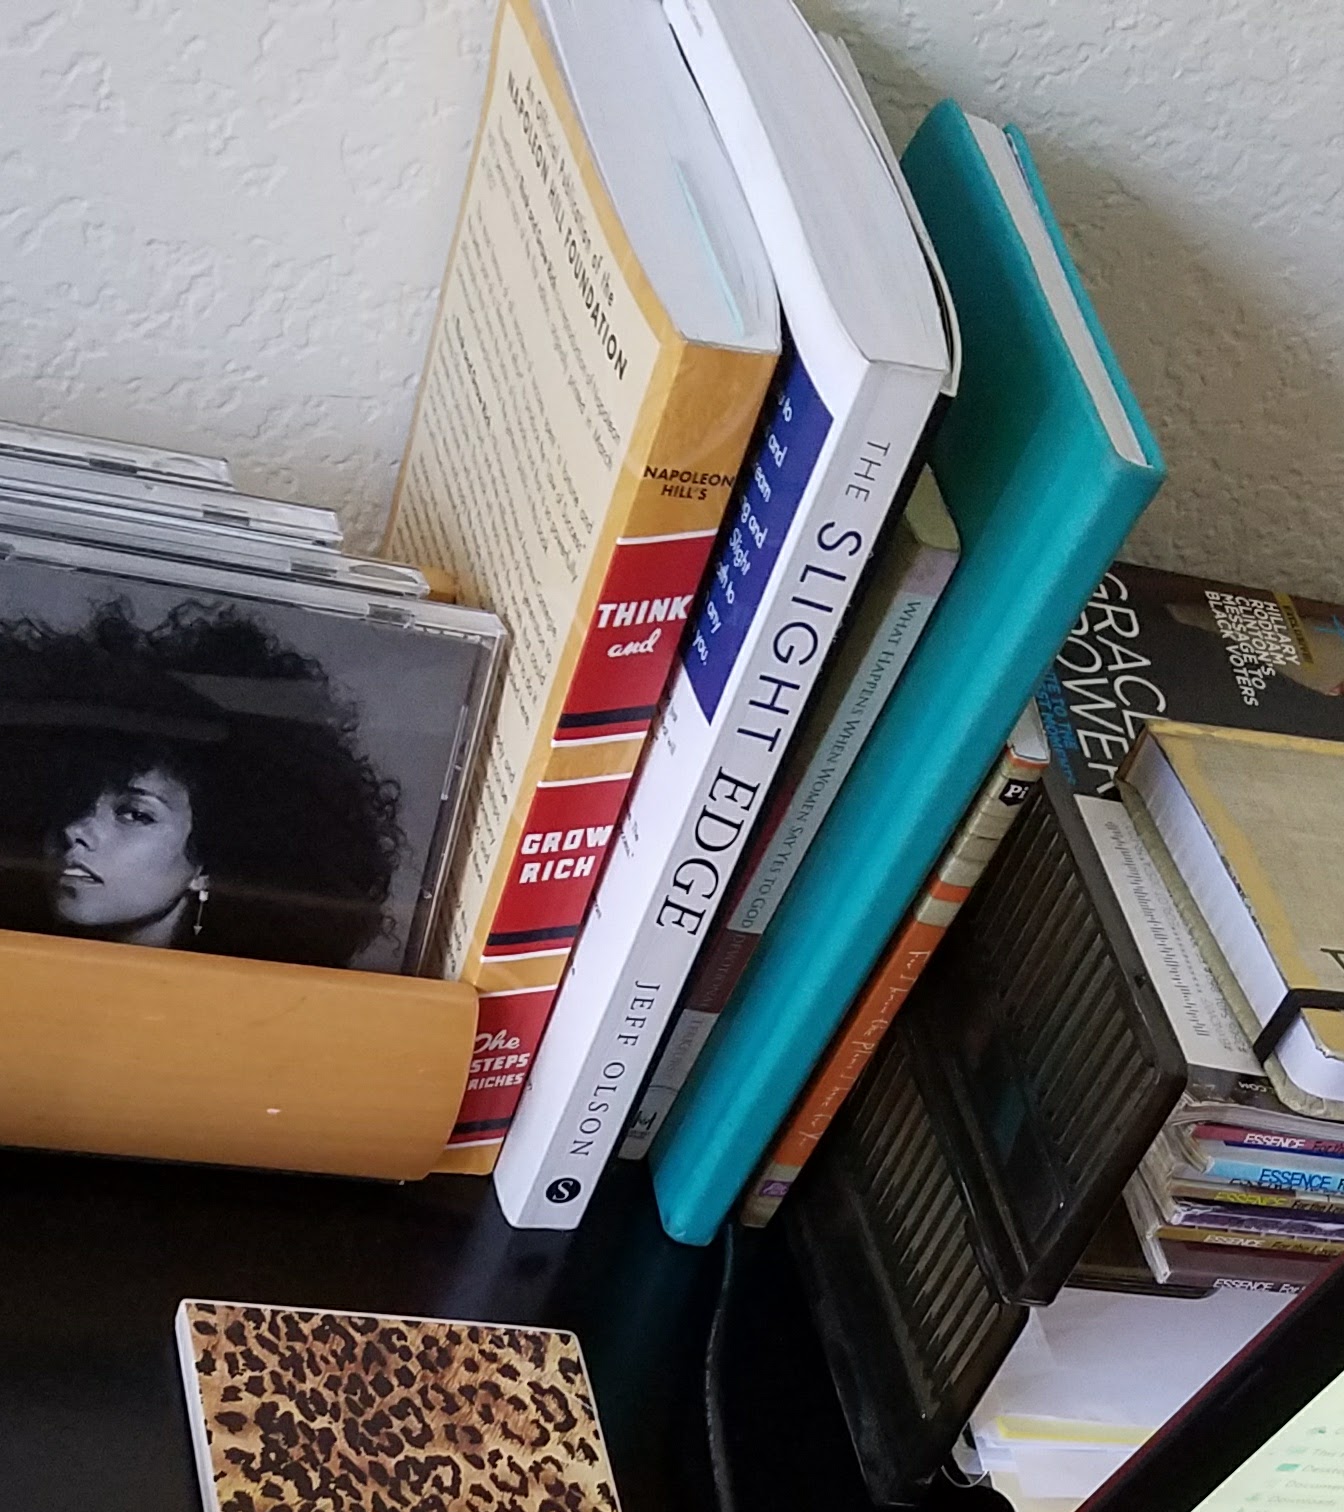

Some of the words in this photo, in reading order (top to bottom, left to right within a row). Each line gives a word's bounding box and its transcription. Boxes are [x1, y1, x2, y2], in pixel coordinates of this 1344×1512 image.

[507, 69, 549, 184] NAPOLEON
[548, 179, 566, 234] HILL
[564, 227, 628, 380] FOUNDATION
[644, 465, 738, 488] NAPOLEON
[844, 440, 891, 503] THE
[597, 594, 695, 629] THINK
[885, 600, 921, 645] WHAT
[1219, 592, 1259, 667] MESSAGE
[1248, 597, 1287, 667] RODHAM
[1262, 600, 1301, 666] HILLARY
[607, 628, 662, 658] and
[737, 521, 863, 752] SLIGHT
[1204, 589, 1236, 640] BLACK
[1225, 644, 1260, 707] VOTERS
[1234, 595, 1276, 678] CLINTON'S
[849, 650, 896, 715] HAPPENS
[825, 719, 860, 763] WHEN
[794, 765, 835, 822] WOMEN
[520, 825, 614, 856] GROW
[656, 766, 761, 937] EDGE
[780, 825, 804, 848] SAY
[518, 855, 596, 884] RICH
[739, 897, 767, 929] GOD
[617, 980, 662, 1048] JEFF
[467, 1072, 525, 1091] RICHES
[469, 1053, 530, 1073] STEPS
[570, 1060, 626, 1157] OLSON
[1244, 1133, 1306, 1149] ESSENCE
[1259, 1168, 1332, 1189] ESSENCE
[1204, 1235, 1266, 1248] ESSENCE
[1213, 1278, 1274, 1291] ESSENCE
[1279, 1284, 1300, 1294] For
